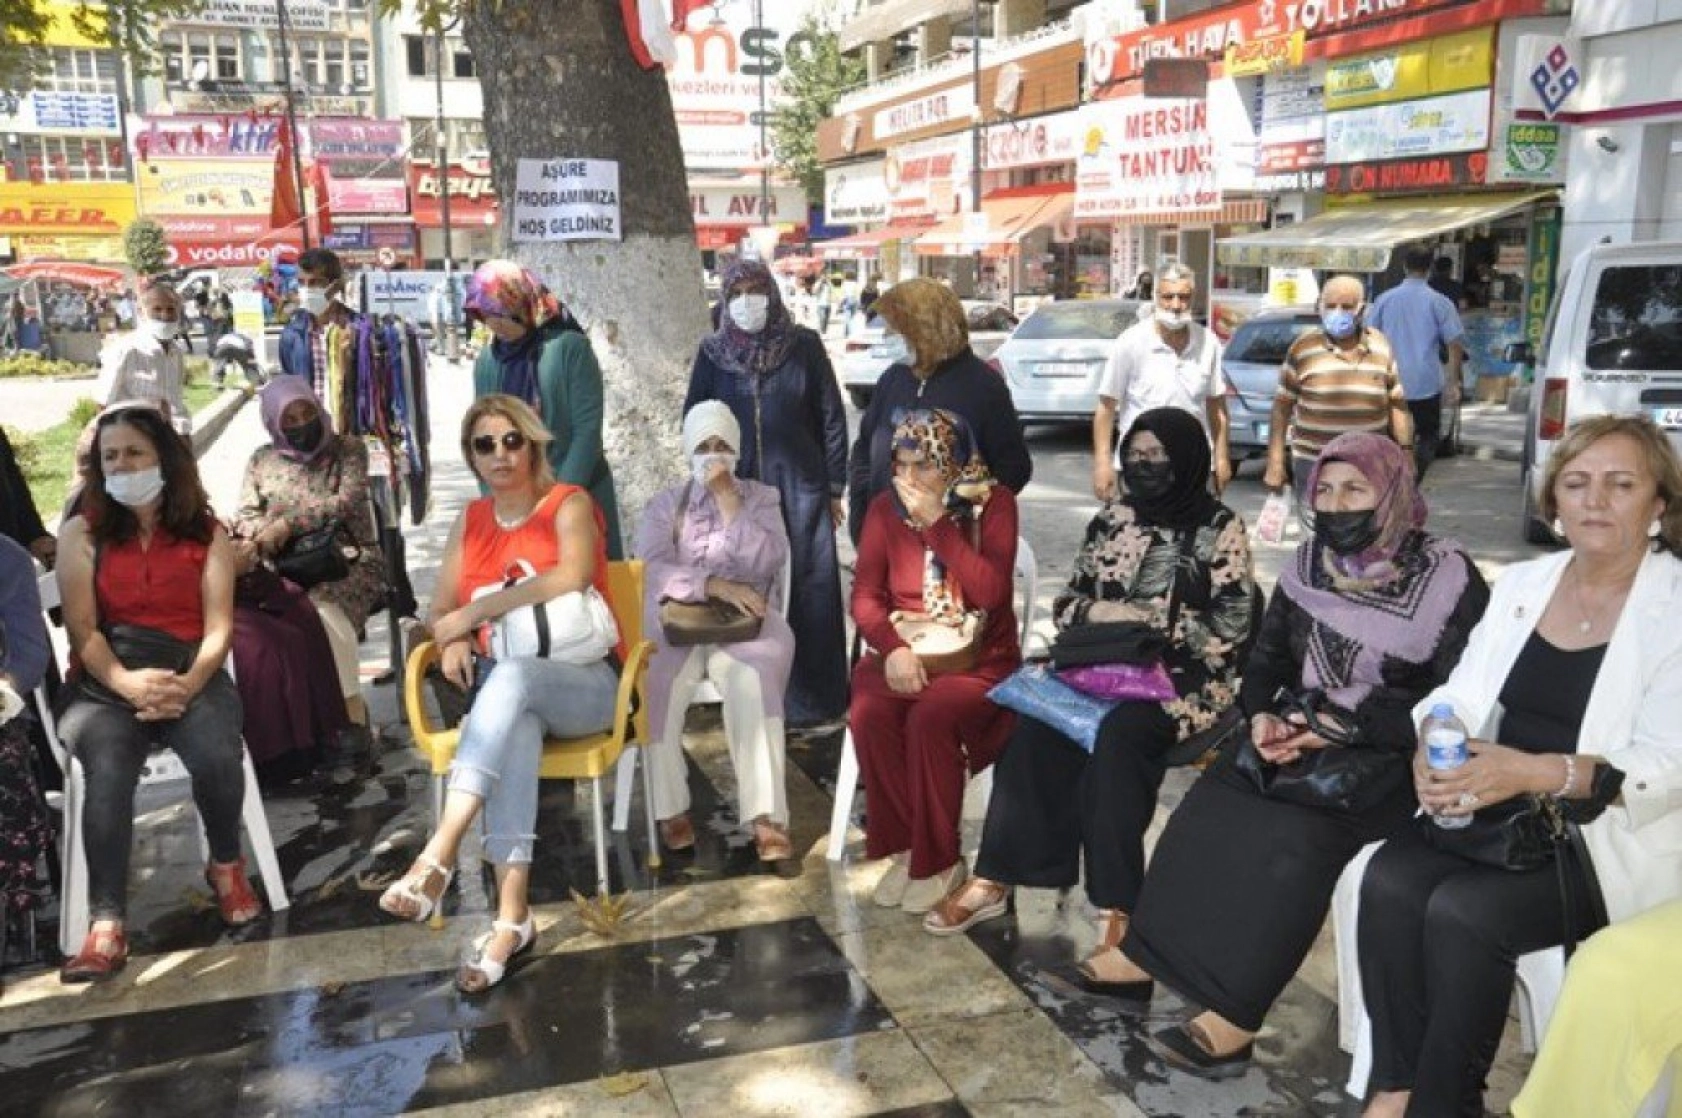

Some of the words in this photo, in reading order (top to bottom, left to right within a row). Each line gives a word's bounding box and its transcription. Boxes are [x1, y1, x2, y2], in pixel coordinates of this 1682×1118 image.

[541, 161, 588, 182] AŞURE
[517, 188, 617, 208] PROGRAMIMIZA
[519, 218, 547, 238] HOŞ
